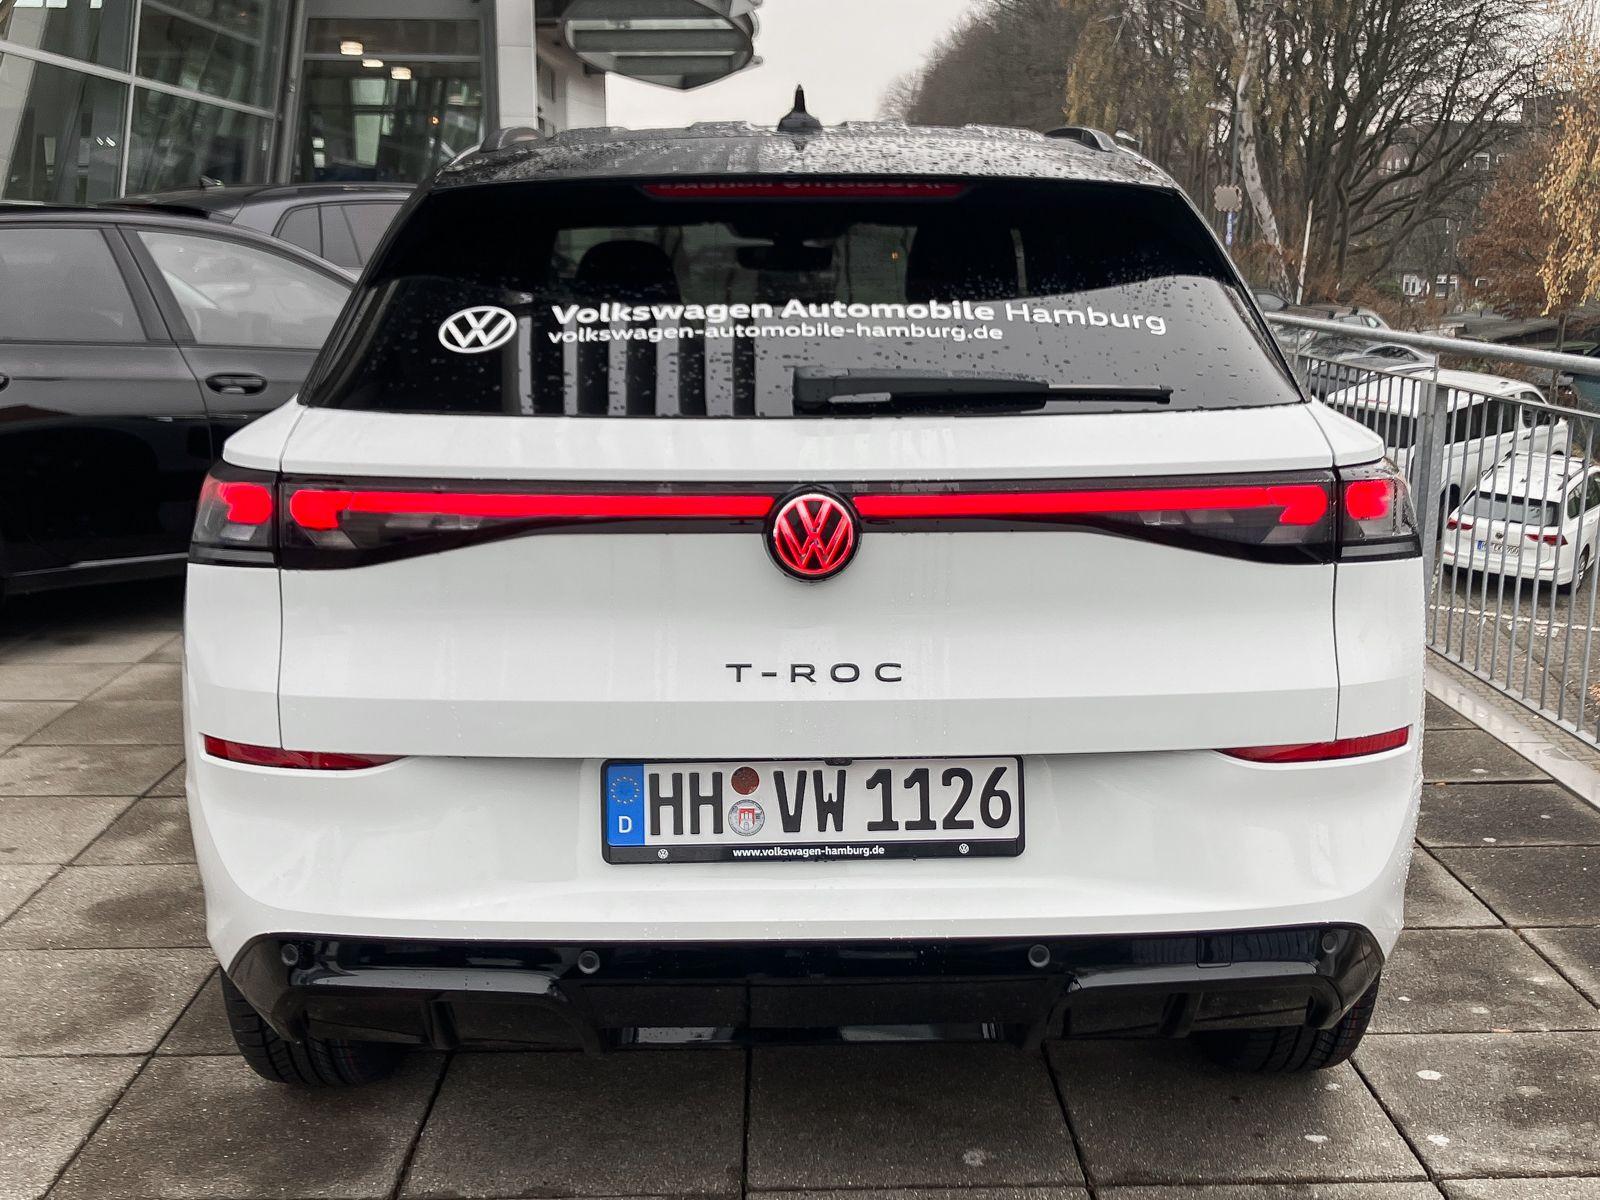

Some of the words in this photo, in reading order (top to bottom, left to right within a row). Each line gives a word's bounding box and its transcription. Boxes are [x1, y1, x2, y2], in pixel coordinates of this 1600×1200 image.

[440, 307, 516, 352] VW
[551, 302, 774, 324] Volkswagen
[781, 299, 995, 321] Automobile
[1005, 303, 1167, 335] Hamburg
[547, 323, 1004, 343] volkswagen-automobile-hamburg.de
[774, 494, 853, 574] VW
[725, 663, 902, 683] T-ROC
[648, 771, 724, 836] HH
[772, 769, 847, 833] VW
[865, 766, 1012, 832] 1126
[618, 815, 633, 834] D
[732, 844, 885, 858] www.volkswagen-hamburg.de
